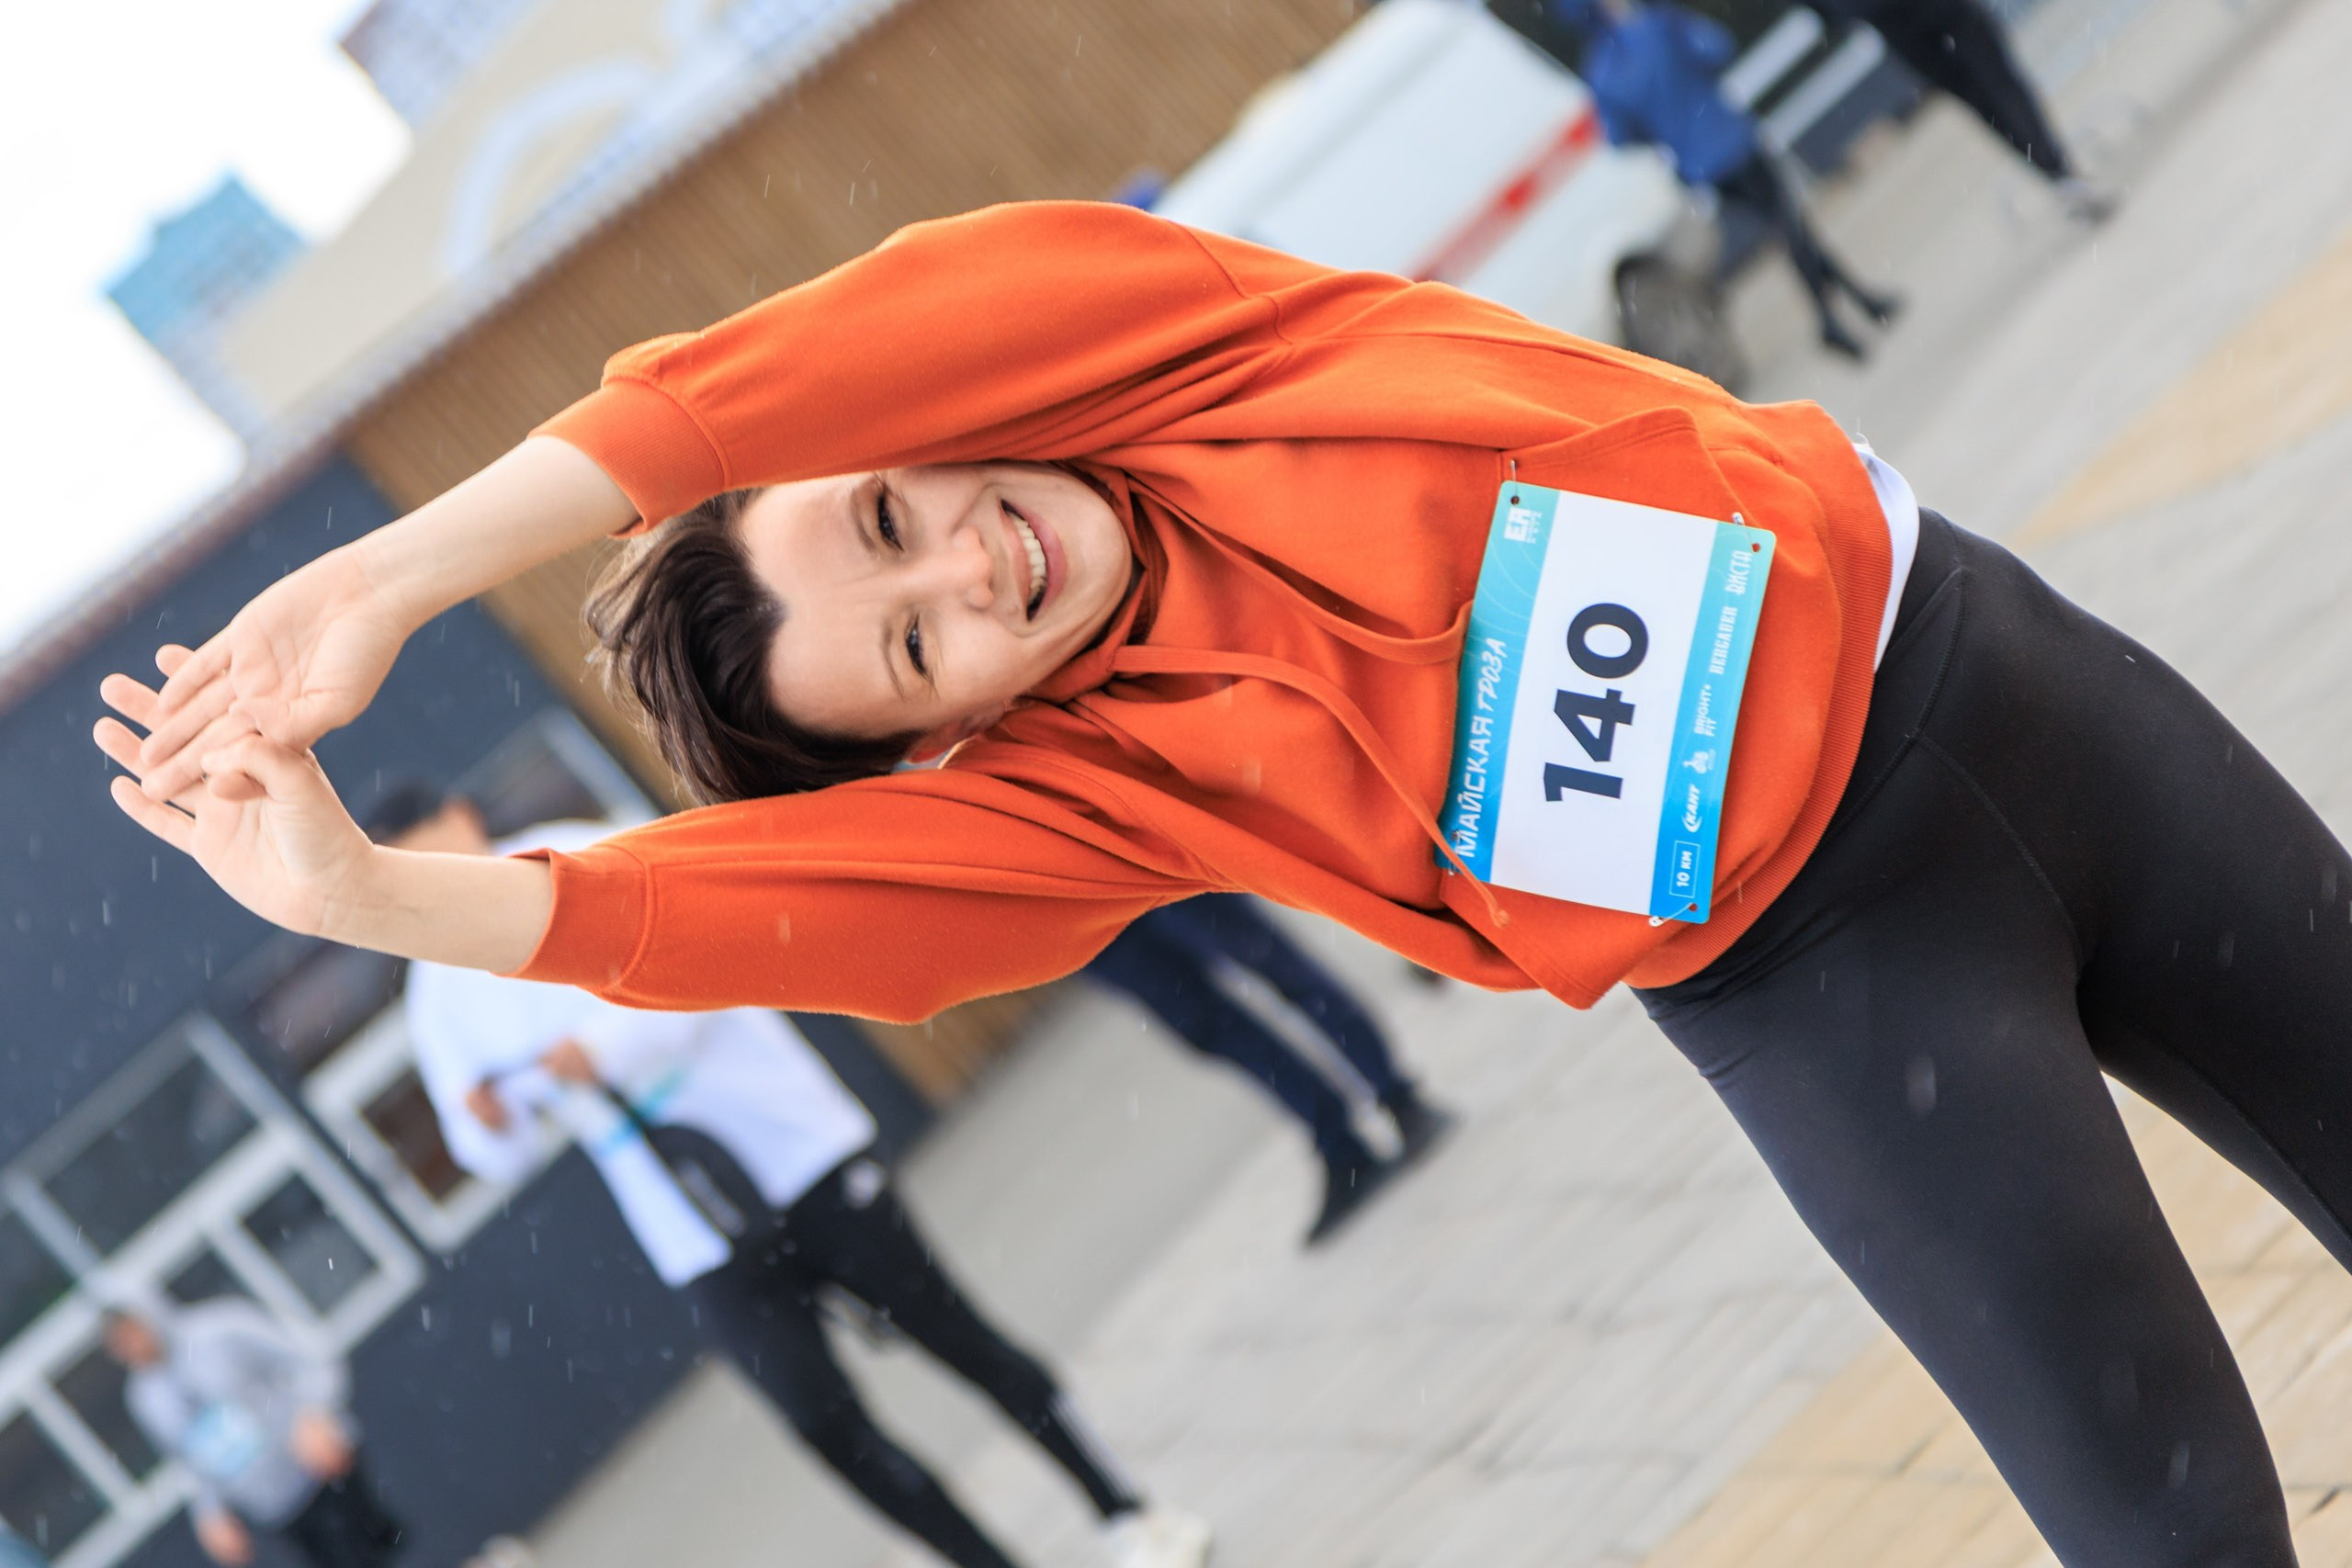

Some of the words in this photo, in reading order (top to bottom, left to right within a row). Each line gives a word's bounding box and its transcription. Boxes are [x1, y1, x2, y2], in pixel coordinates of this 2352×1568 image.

[1455, 715, 1494, 858] МАЙСКАЯ
[1477, 637, 1508, 712] ГРОЗА
[1544, 603, 1649, 802] 140
[1676, 872, 1690, 887] 10
[1680, 850, 1692, 870] КМ
